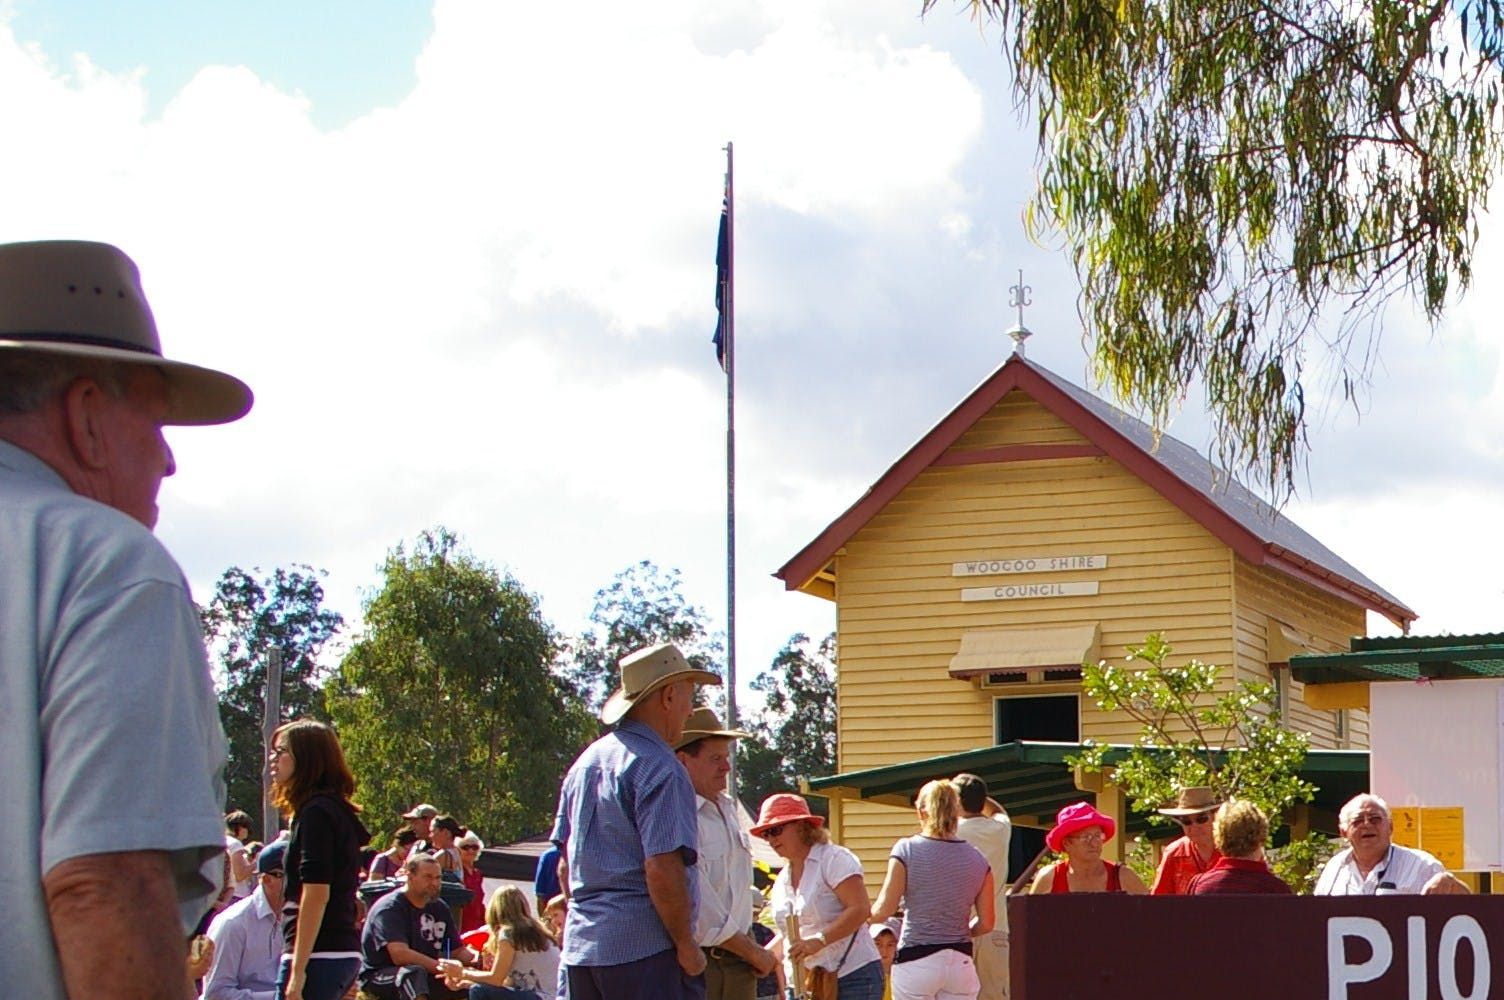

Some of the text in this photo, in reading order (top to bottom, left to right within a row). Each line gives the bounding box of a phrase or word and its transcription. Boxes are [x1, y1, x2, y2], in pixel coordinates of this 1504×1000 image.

[966, 556, 1094, 573] WOOCOO SHIRE
[994, 584, 1065, 598] COUNCIL
